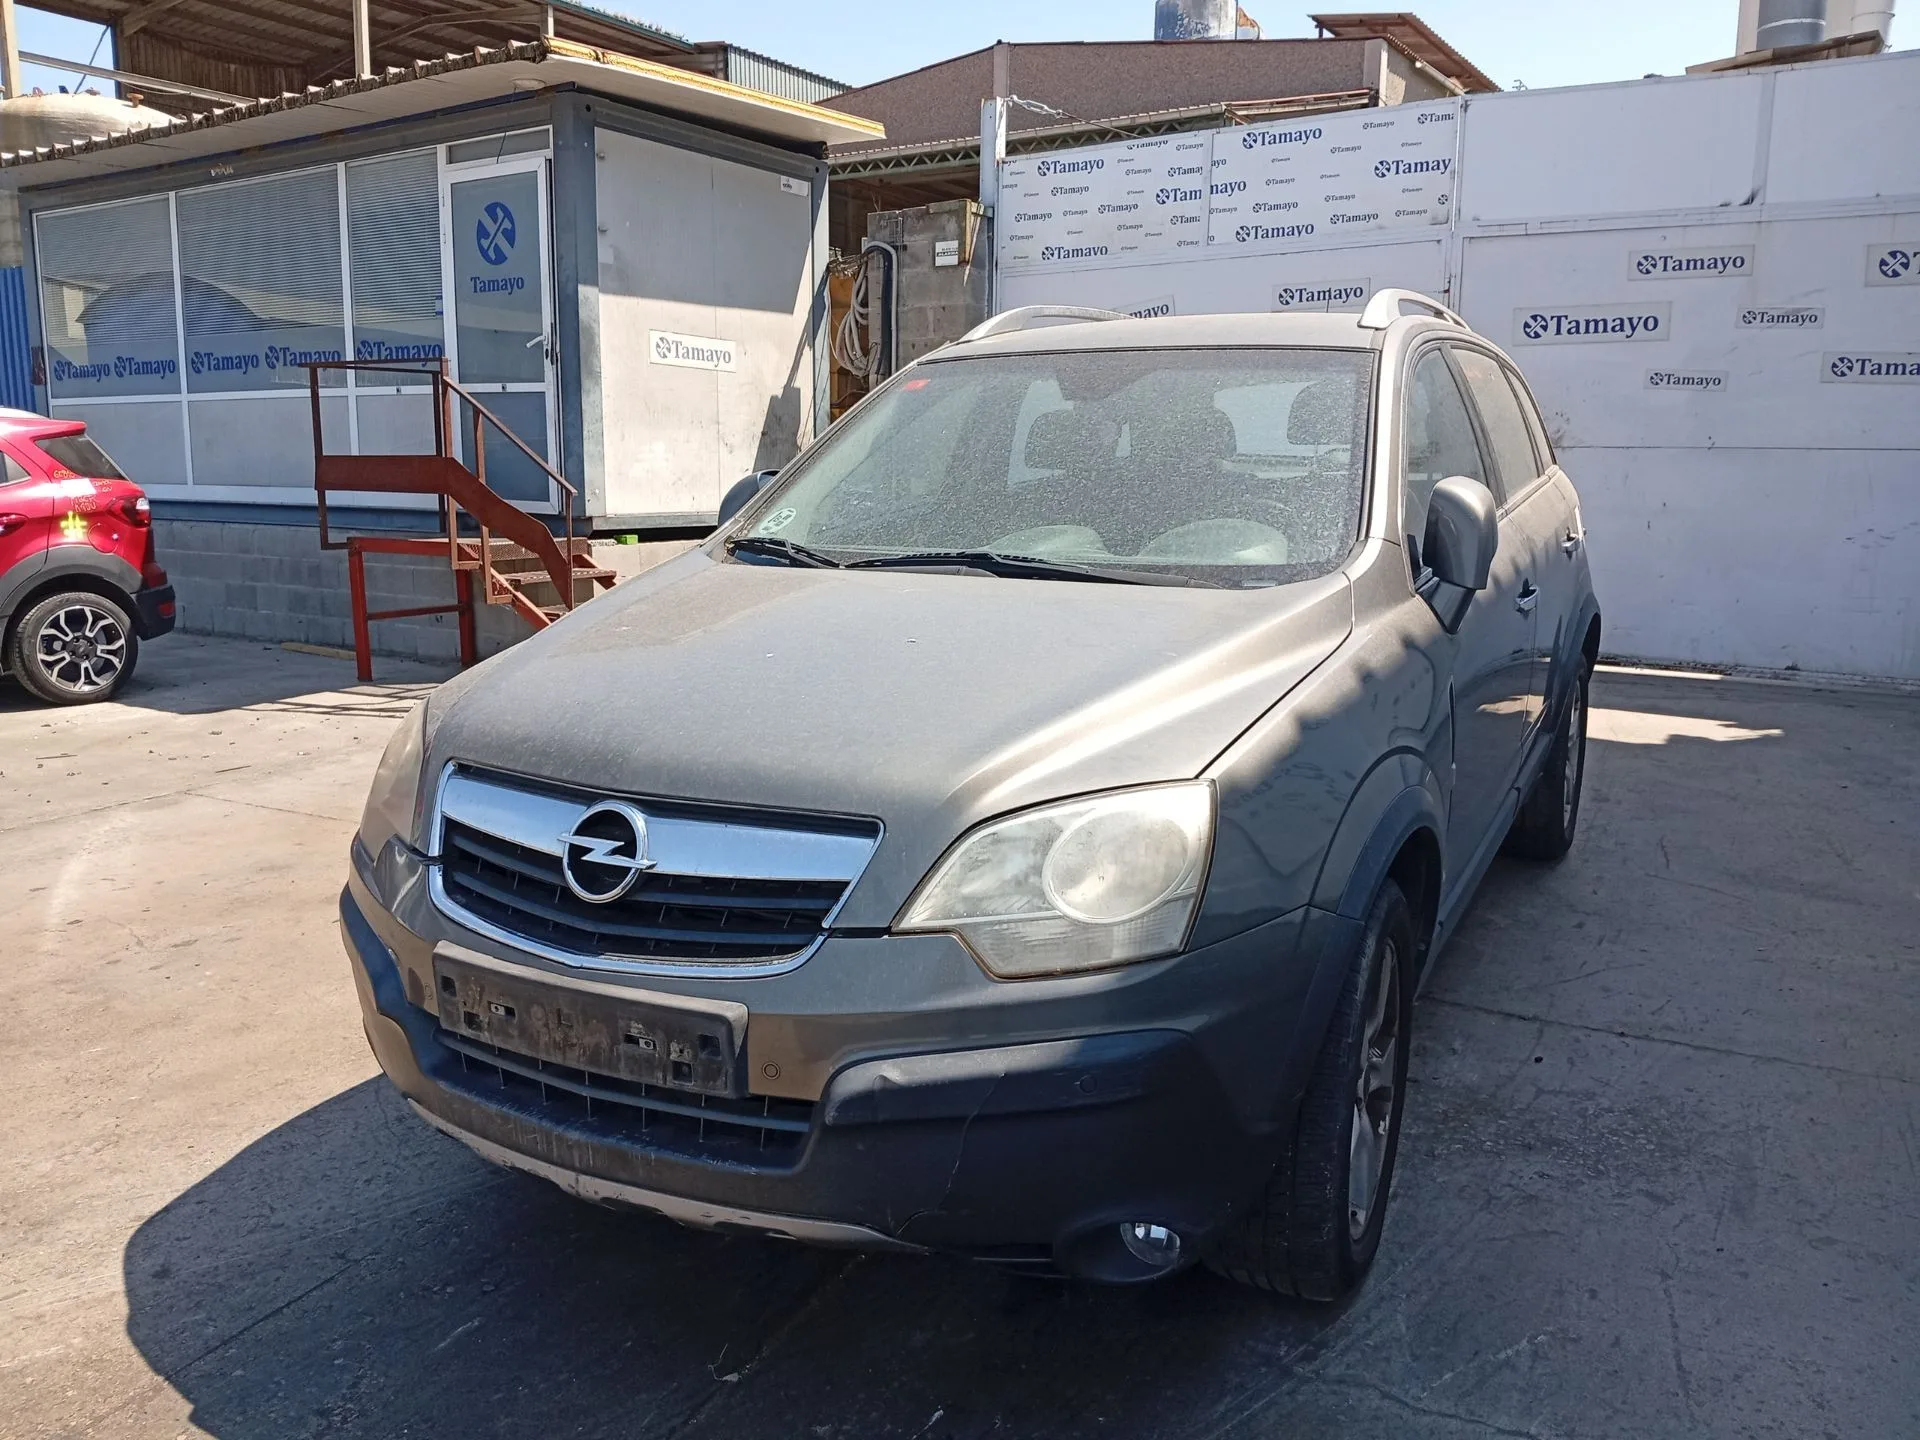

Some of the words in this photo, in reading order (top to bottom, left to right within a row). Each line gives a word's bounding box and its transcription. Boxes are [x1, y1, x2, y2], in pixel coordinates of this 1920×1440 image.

[1368, 121, 1395, 129] Tamayo
[1258, 128, 1322, 146] Tamayo
[1181, 142, 1204, 150] Tamayo
[1337, 145, 1361, 153] Tamayo
[1051, 159, 1104, 174] Tamayo
[1391, 158, 1452, 176] Tamay
[1271, 177, 1295, 186] Tamayo
[1059, 185, 1090, 195] Tamayo
[1331, 193, 1356, 202] Tamayo
[1106, 203, 1139, 213] Tamayo
[1261, 201, 1298, 212] Tamayo
[1401, 208, 1428, 216] Tamayo
[1022, 211, 1053, 221] Tamayo
[1339, 212, 1379, 224] Tamayo
[1122, 223, 1143, 231] Tamayo
[1251, 223, 1315, 240] Tamayo
[1658, 254, 1746, 275] Tamayo
[470, 276, 525, 295] Tamayo
[1295, 286, 1364, 304] Tamayo
[1757, 310, 1819, 326] Tamayo
[1550, 314, 1660, 339] Tamayo
[279, 347, 341, 371] Tamayo
[373, 341, 443, 367] Tamayo
[671, 340, 732, 368] Tamayo
[126, 356, 176, 379] Tamayo
[204, 351, 259, 374] Tamayo
[1855, 358, 1920, 376] Tama
[65, 361, 110, 382] Tamayo
[1664, 373, 1722, 388] Tamayo
